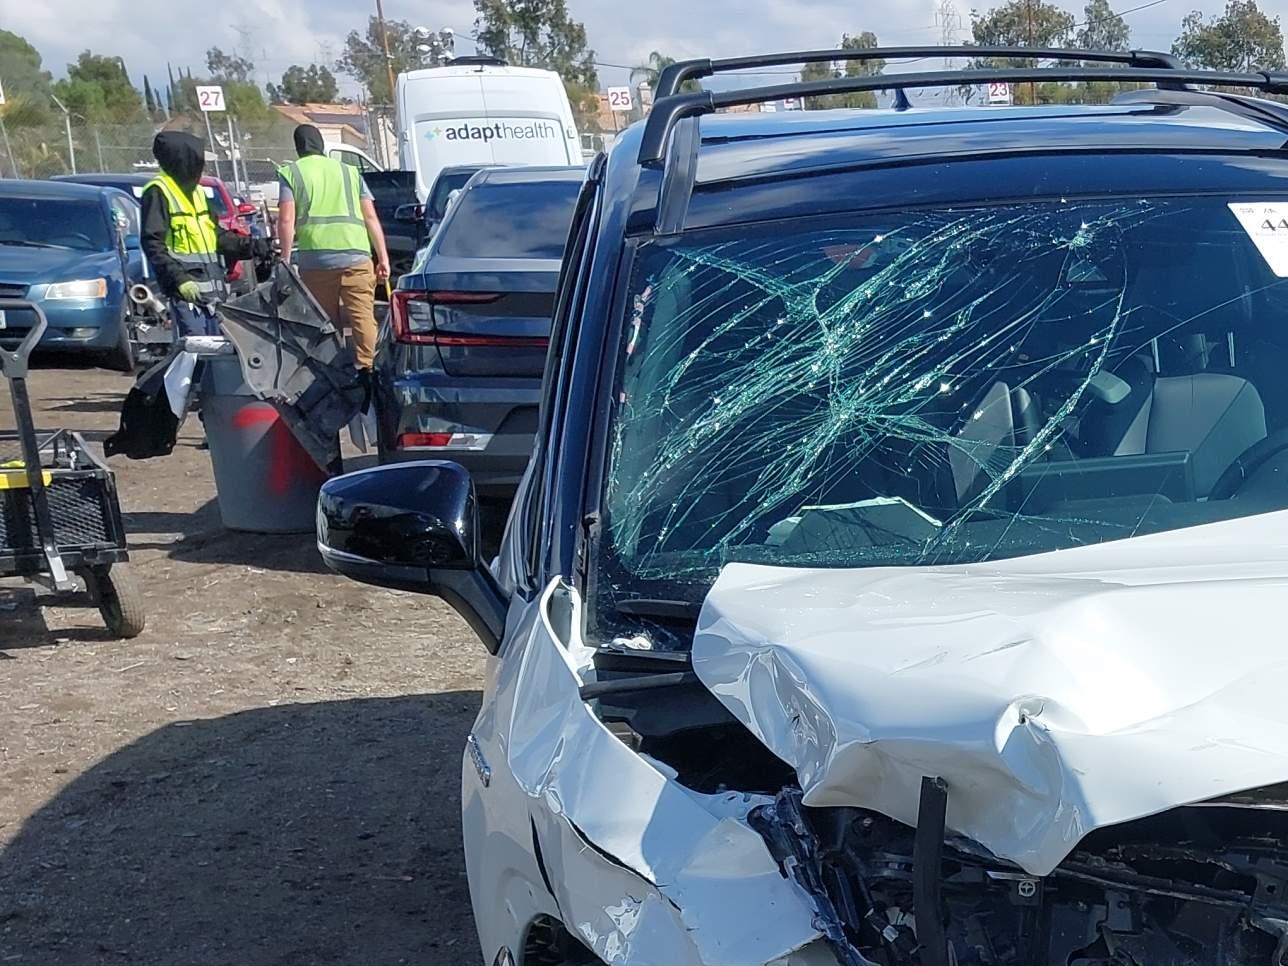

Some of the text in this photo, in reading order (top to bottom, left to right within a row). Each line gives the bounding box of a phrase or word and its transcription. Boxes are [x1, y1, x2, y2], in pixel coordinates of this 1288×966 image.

[990, 82, 1007, 96] 23
[200, 91, 220, 106] 27
[610, 91, 630, 106] 25
[446, 122, 555, 142] adapthealth
